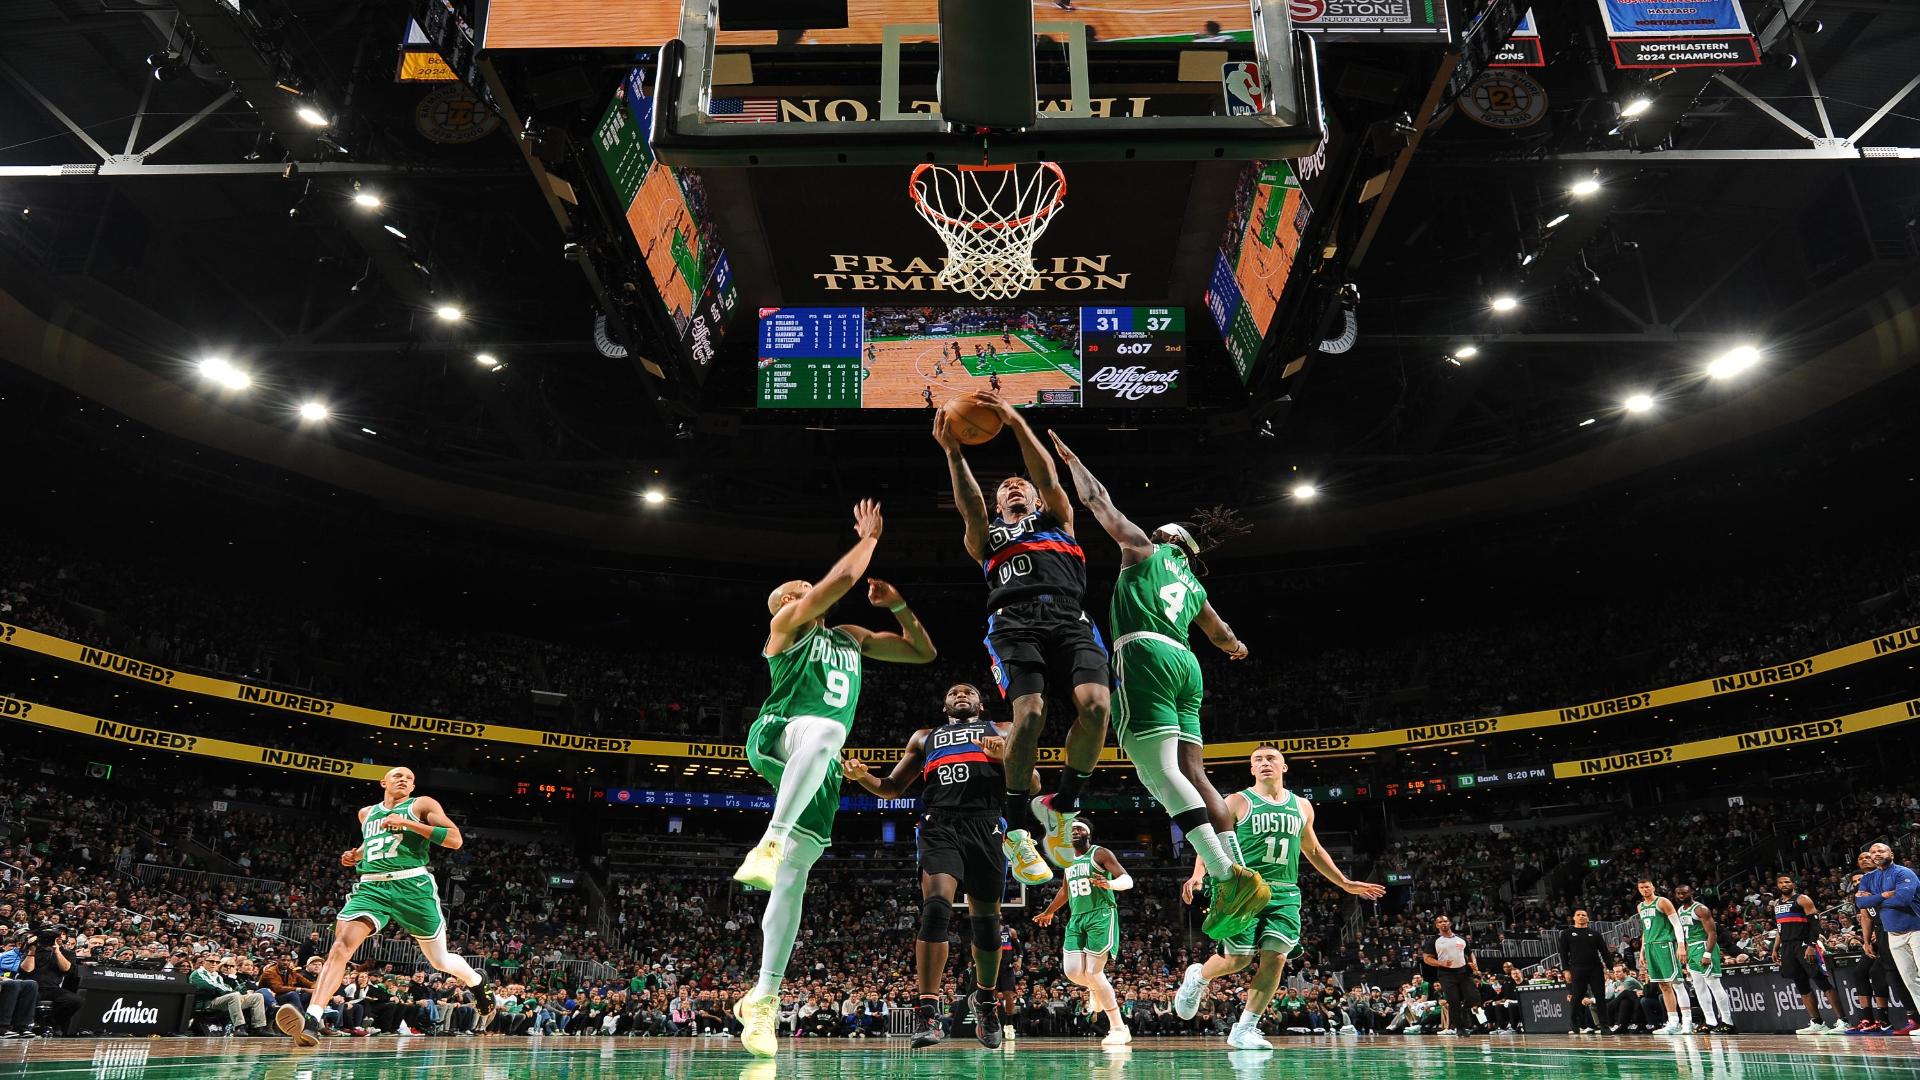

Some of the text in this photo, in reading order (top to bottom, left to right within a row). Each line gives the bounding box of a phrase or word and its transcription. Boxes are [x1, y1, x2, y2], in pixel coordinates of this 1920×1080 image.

[1329, 4, 1404, 15] STONE
[1636, 52, 1739, 61] 2024 CHAMPIONS
[1640, 43, 1729, 52] NORTHEASTERN
[1096, 317, 1172, 331] 31 37
[1116, 343, 1153, 354] 6:07
[1087, 366, 1180, 390] Different
[1114, 381, 1169, 401] Here
[988, 513, 1037, 551] DET
[998, 554, 1034, 585] 00
[1159, 582, 1189, 623] 4
[79, 646, 175, 685] INJURED?
[810, 635, 859, 677] BOSTON
[1712, 658, 1814, 693] INJURED?
[237, 684, 335, 715] INJURED?
[823, 669, 850, 709] 9
[1558, 693, 1652, 723] INJURED?
[94, 718, 198, 751] INJURED?
[389, 713, 487, 738] INJURED?
[1406, 718, 1499, 742] INJURED?
[1737, 718, 1843, 749] INJURED?
[541, 731, 633, 753] INJURED?
[687, 743, 747, 759] INJUR
[934, 728, 985, 749] DET
[260, 748, 355, 776] INJURED?
[1579, 747, 1673, 774] INJURED?
[937, 763, 970, 786] 28
[1460, 774, 1499, 785] TD Bank
[1507, 769, 1546, 781] 8:20 PM
[725, 799, 741, 807] 1/15
[749, 801, 771, 809] 14/36
[877, 797, 917, 811] DETROIT
[1251, 812, 1302, 838] BOSTON
[366, 833, 404, 863] 27
[1261, 836, 1290, 866] 11
[1068, 877, 1092, 898] 88
[115, 970, 134, 979] Gorman
[102, 997, 159, 1024] Amica
[1532, 998, 1563, 1023] jetBlue
[1724, 986, 1766, 1013] tBlue
